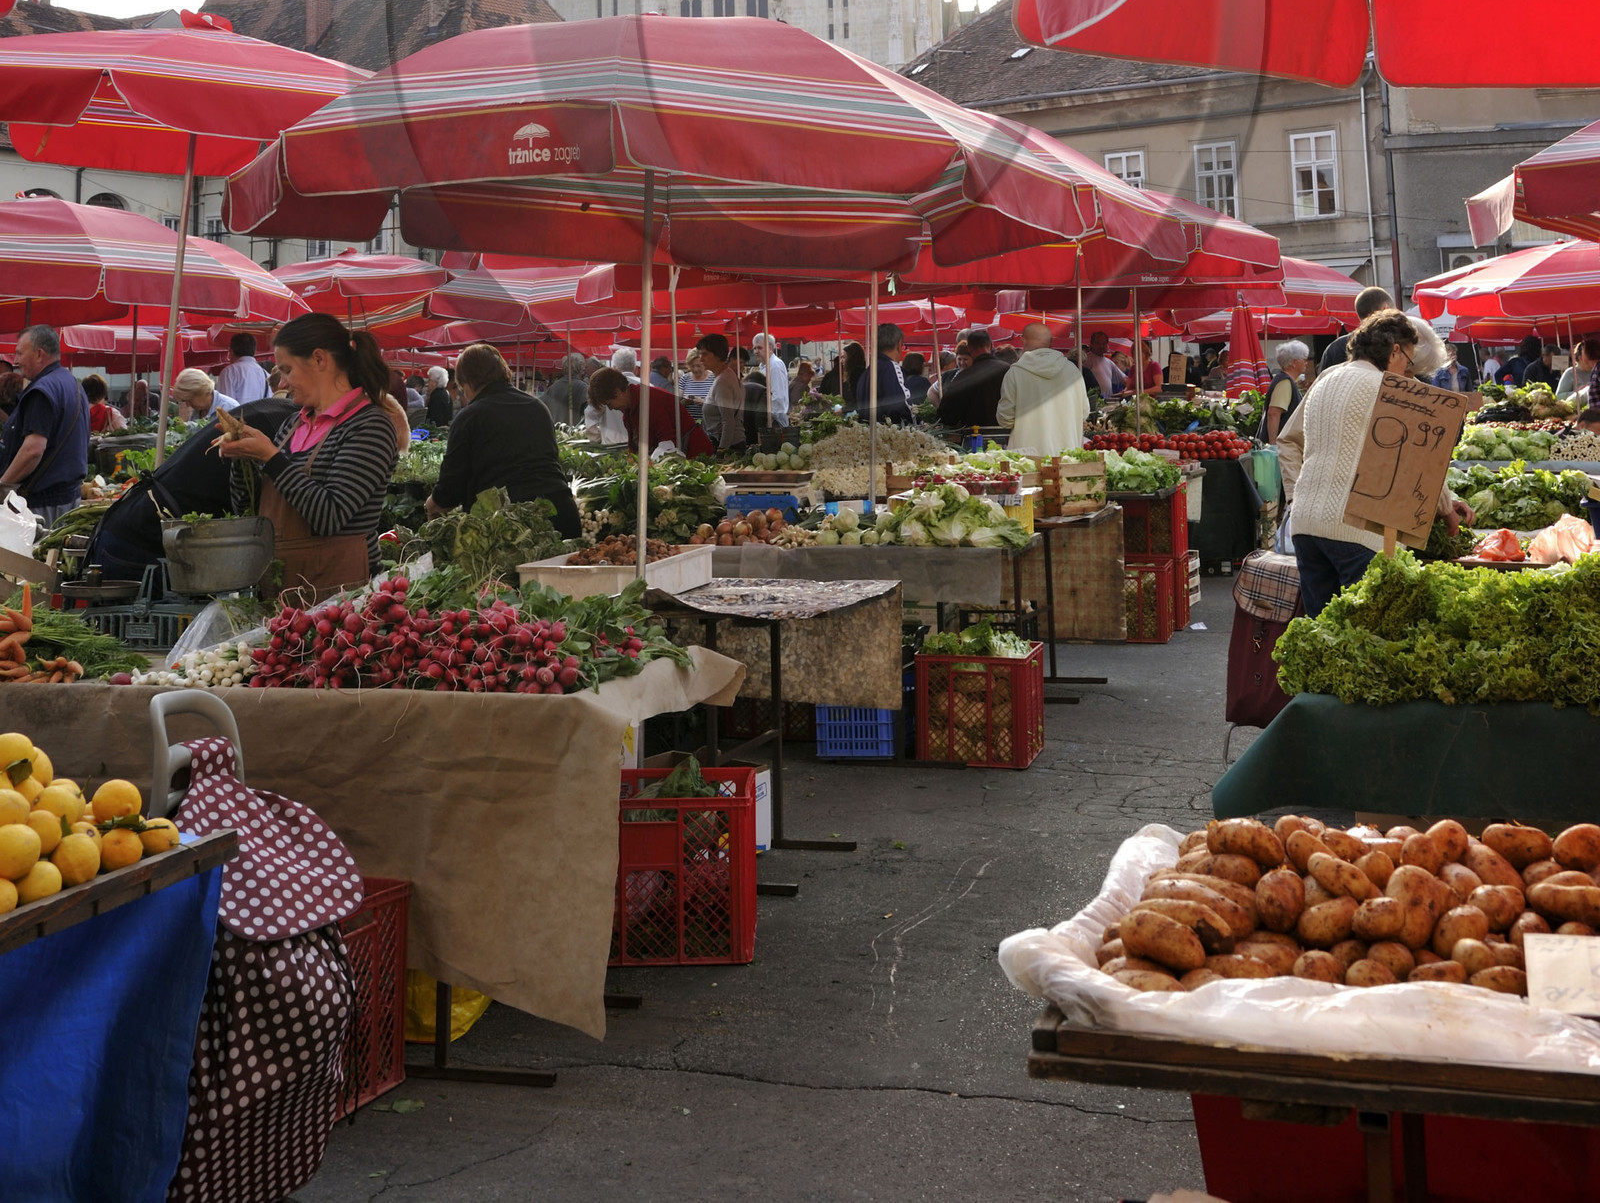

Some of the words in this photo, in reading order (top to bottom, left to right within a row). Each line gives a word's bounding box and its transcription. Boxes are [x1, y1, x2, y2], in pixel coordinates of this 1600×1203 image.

[508, 147, 551, 165] tržnice
[554, 144, 581, 165] zagreb
[1383, 375, 1462, 409] SALATA
